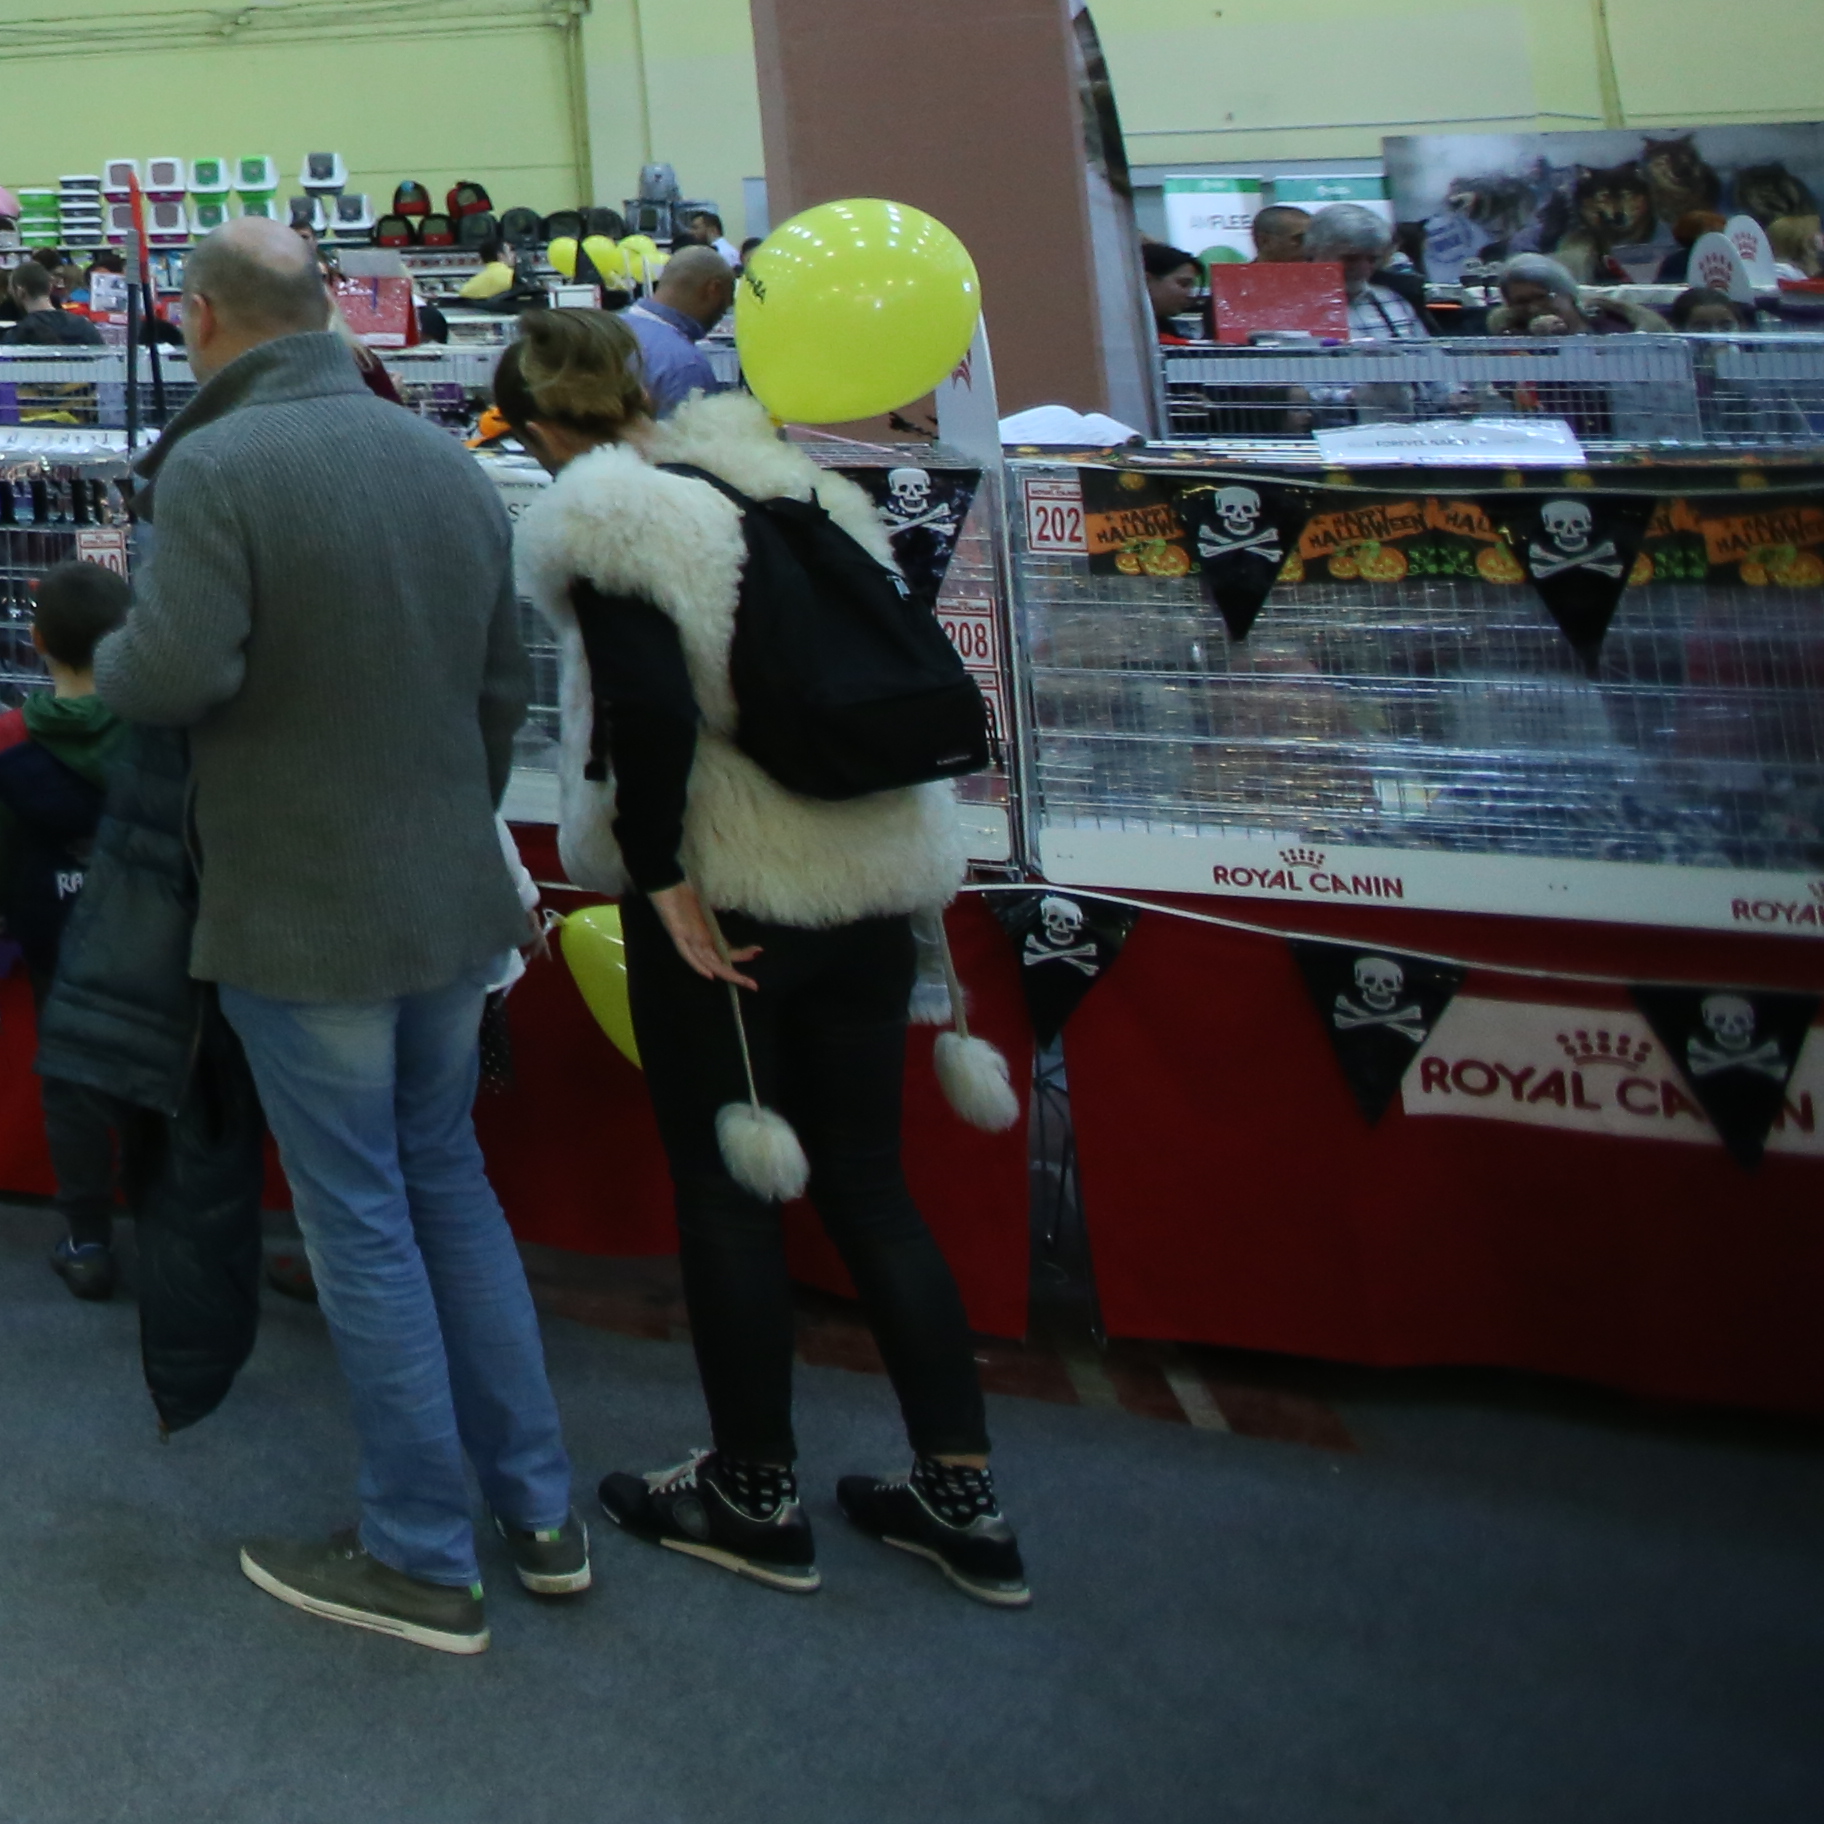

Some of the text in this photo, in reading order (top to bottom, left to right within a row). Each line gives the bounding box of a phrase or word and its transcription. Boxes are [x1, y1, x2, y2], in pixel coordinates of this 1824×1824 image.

[1036, 506, 1083, 543] 202
[1213, 864, 1404, 899] ROYAL CANIN
[1420, 1057, 1815, 1133] ROYAL CAN
